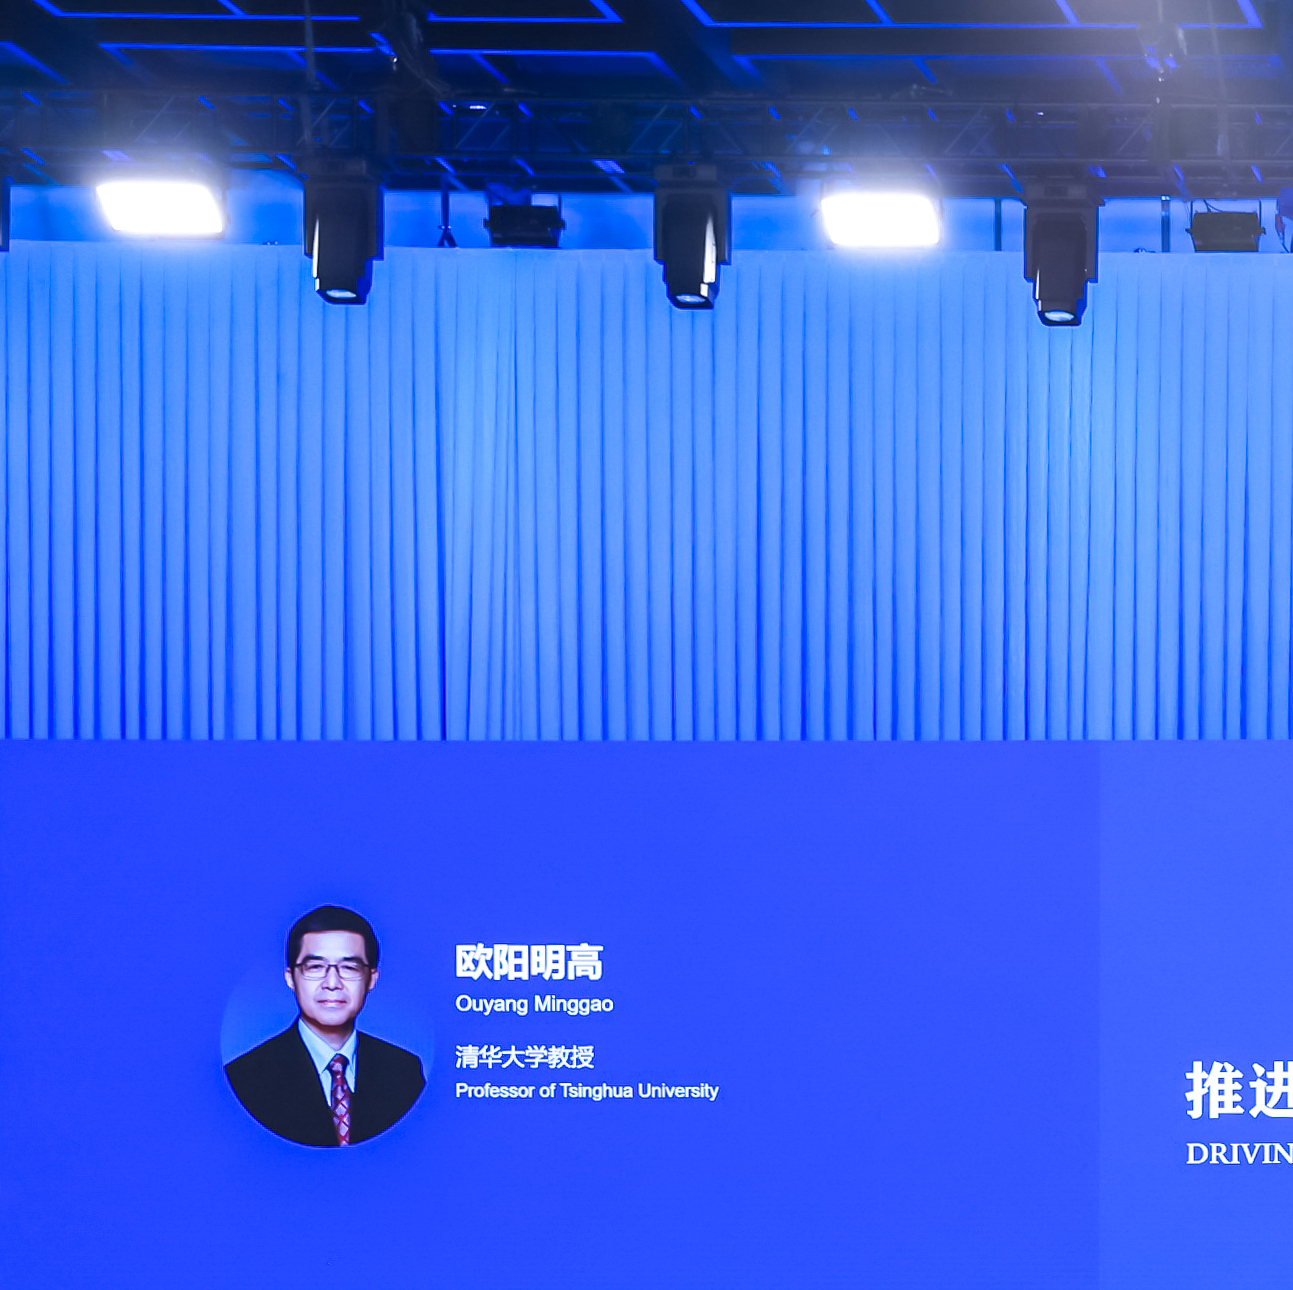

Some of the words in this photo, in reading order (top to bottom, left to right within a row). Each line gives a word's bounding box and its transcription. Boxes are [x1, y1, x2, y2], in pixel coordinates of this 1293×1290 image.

[455, 943, 604, 981] 欧阳明高
[455, 994, 528, 1016] Ouyang
[534, 994, 614, 1016] Minggao
[455, 1045, 595, 1069] 清华大学教授
[455, 1082, 536, 1098] Professor
[538, 1082, 557, 1098] of
[559, 1082, 634, 1102] Tsinghua
[638, 1082, 720, 1102] University
